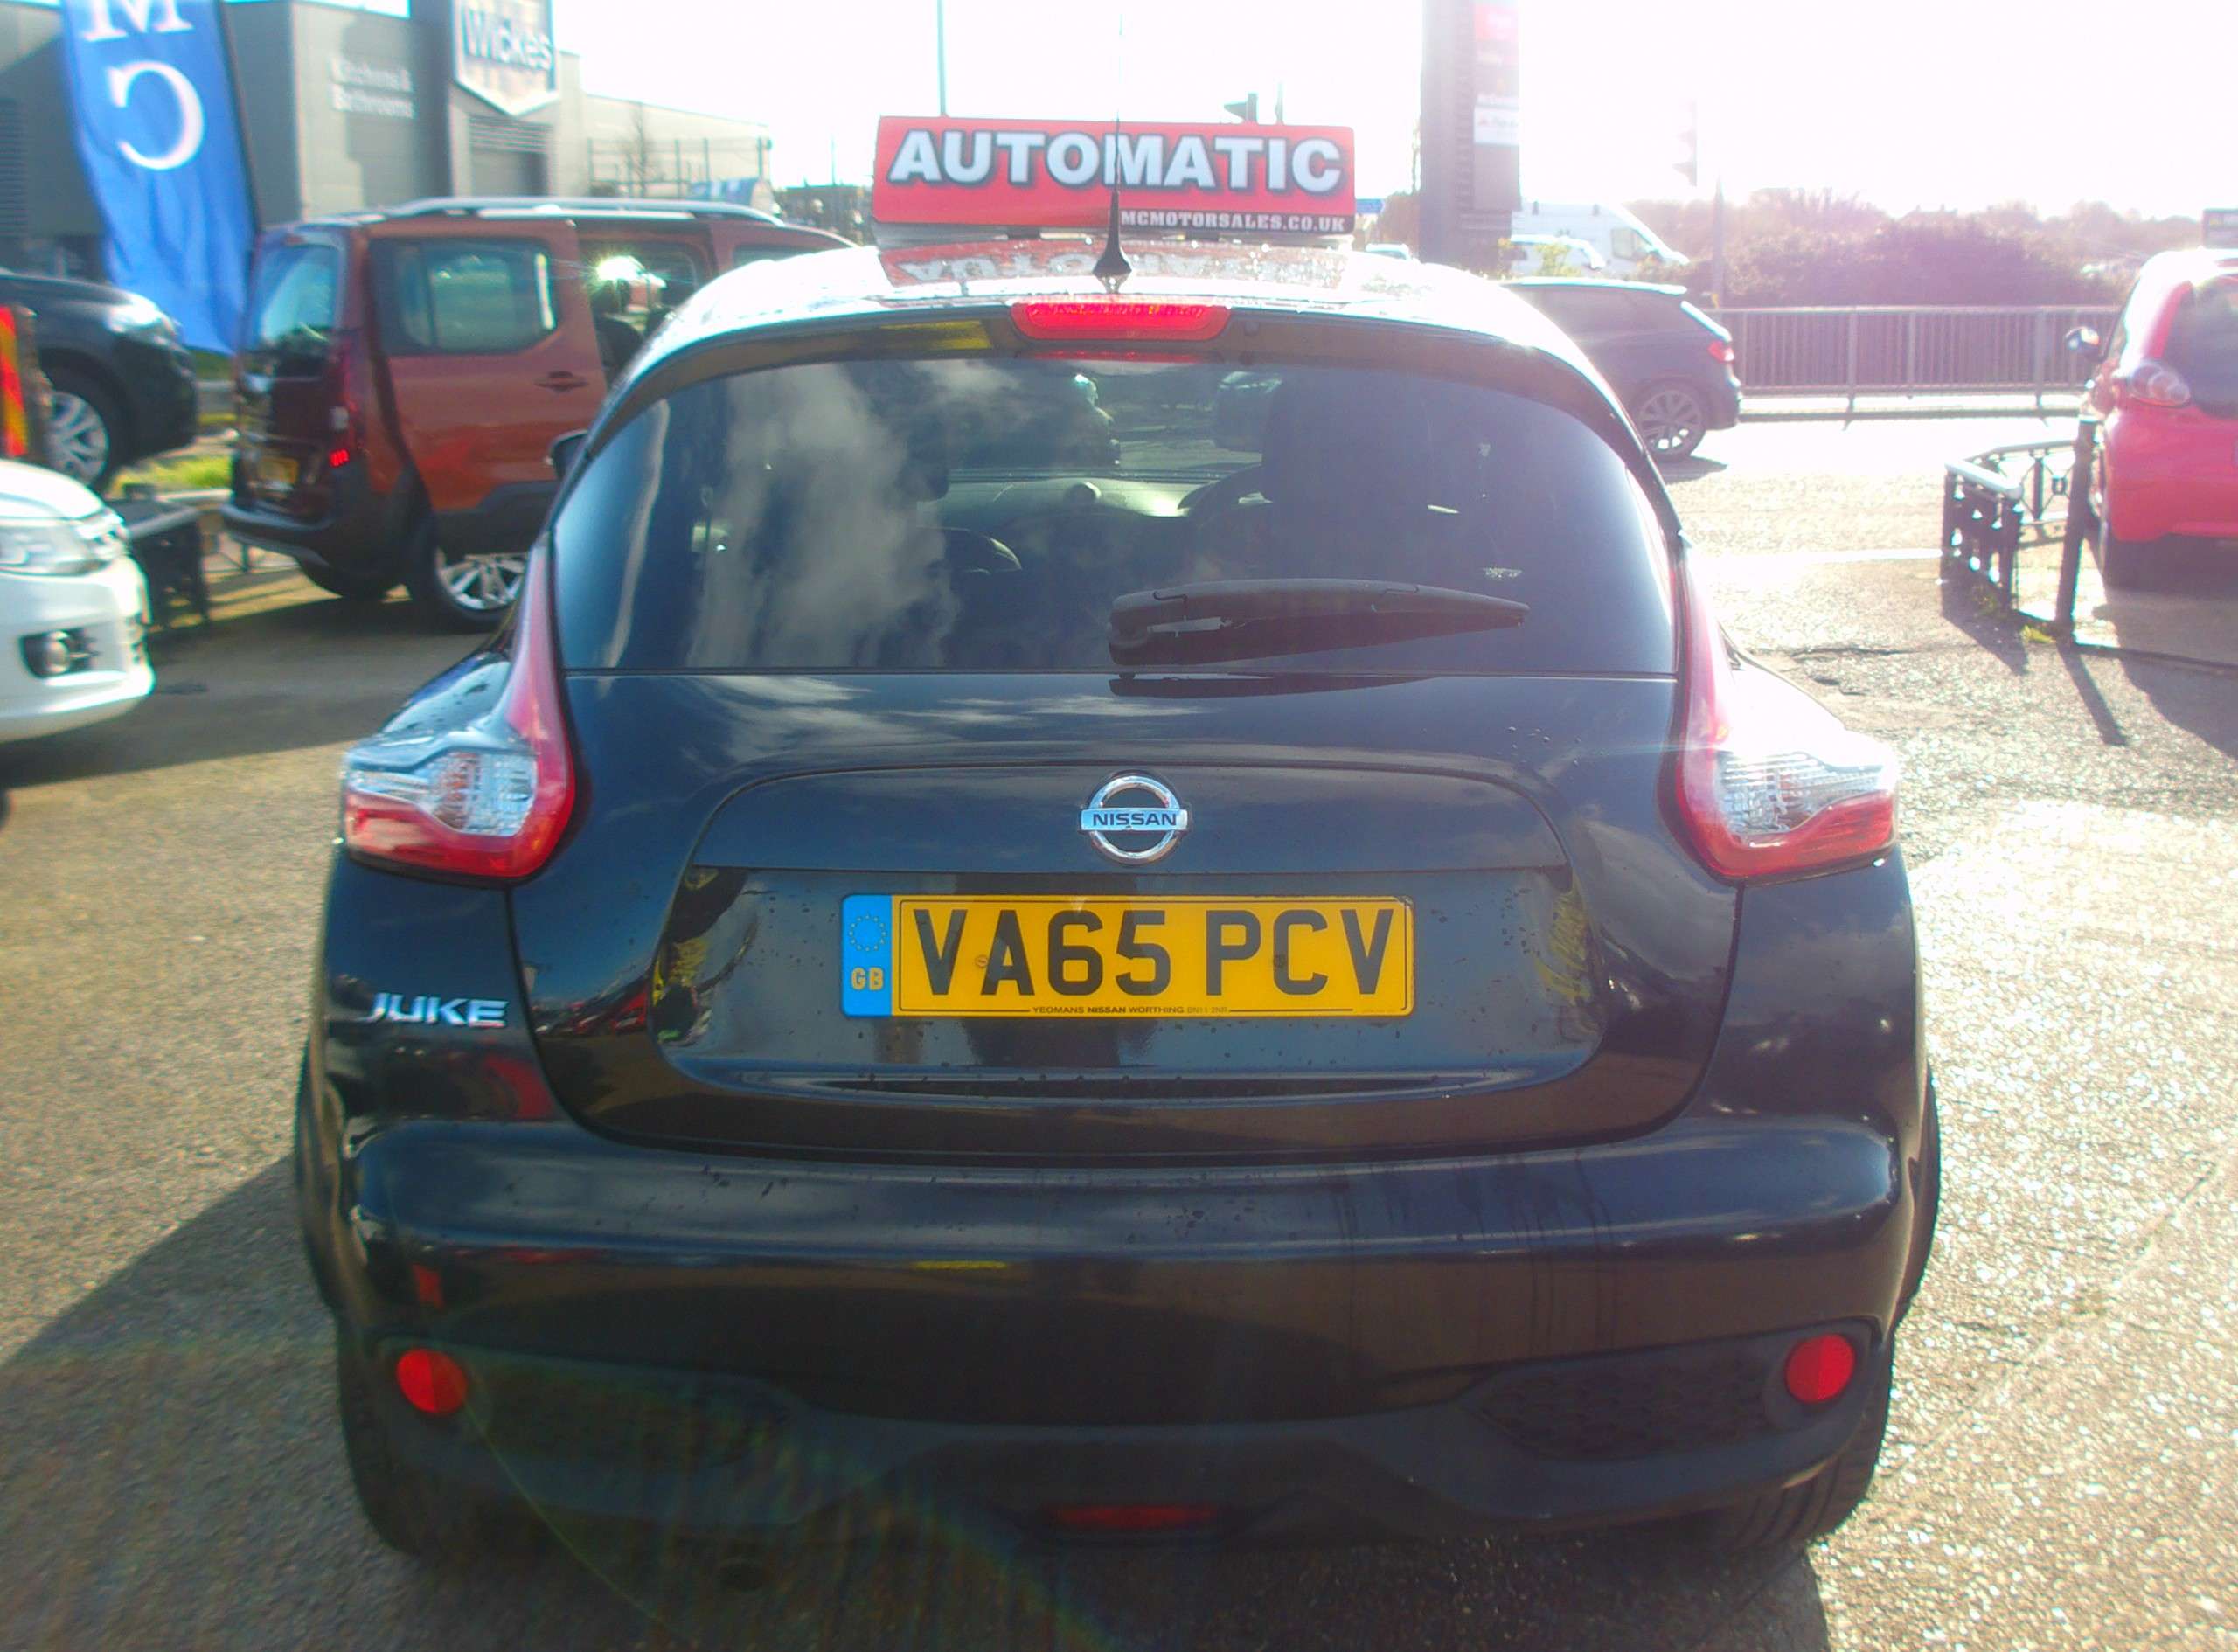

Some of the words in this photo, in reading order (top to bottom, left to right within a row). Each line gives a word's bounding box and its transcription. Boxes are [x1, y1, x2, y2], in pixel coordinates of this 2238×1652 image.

[461, 3, 555, 72] Wickes
[888, 128, 1342, 193] AUTOMATIC
[1120, 210, 1346, 233] MCMOTORSALES.CO.UK
[1092, 812, 1178, 828] NISSAN
[913, 909, 1171, 996] VA65
[1206, 909, 1394, 996] PCV
[851, 967, 884, 991] GB
[357, 991, 509, 1028] JUKE
[1032, 1005, 1084, 1015] YEOMANS
[1087, 1005, 1126, 1015] NISSAN
[1129, 1005, 1185, 1015] WORTHING
